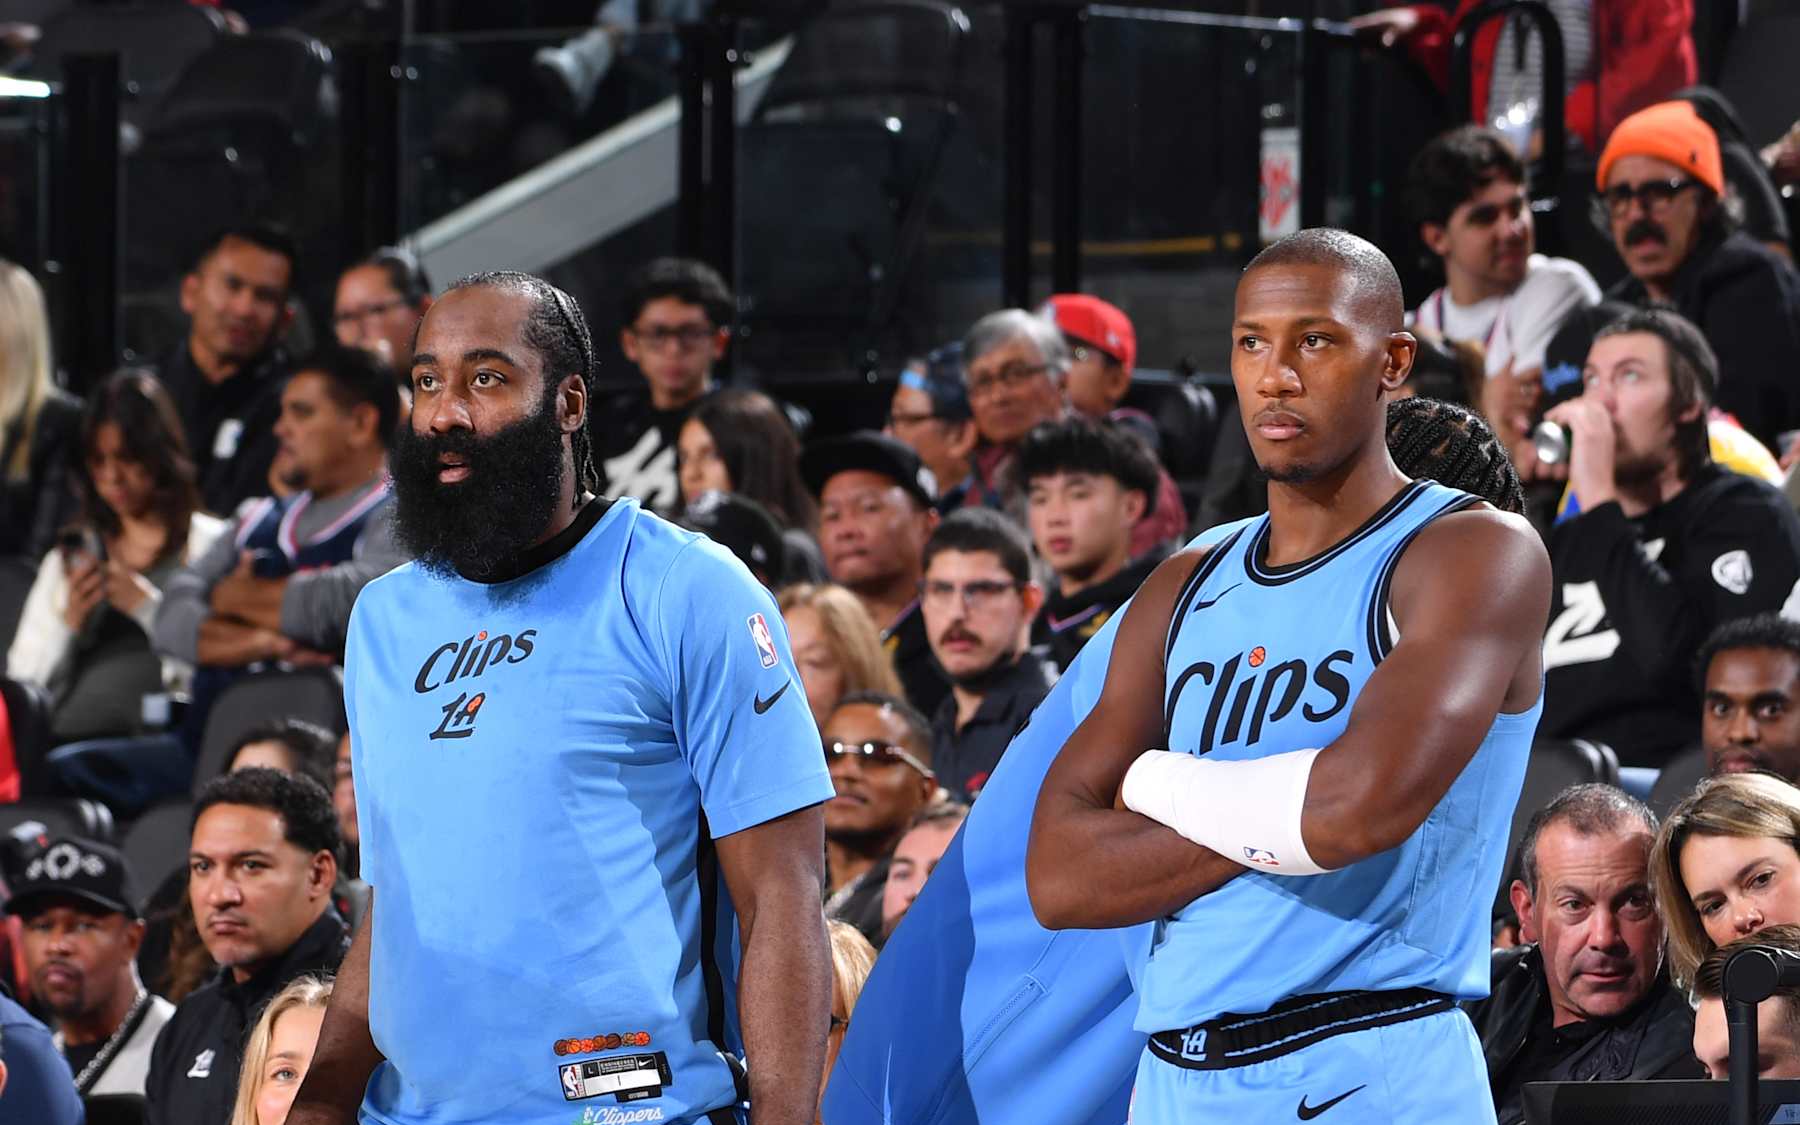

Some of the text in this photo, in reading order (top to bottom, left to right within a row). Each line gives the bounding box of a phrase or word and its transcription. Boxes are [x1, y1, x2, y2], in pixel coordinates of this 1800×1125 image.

[414, 629, 538, 694] Clips
[428, 691, 486, 741] LA
[1167, 645, 1355, 757] Clips
[1180, 1027, 1208, 1062] LA
